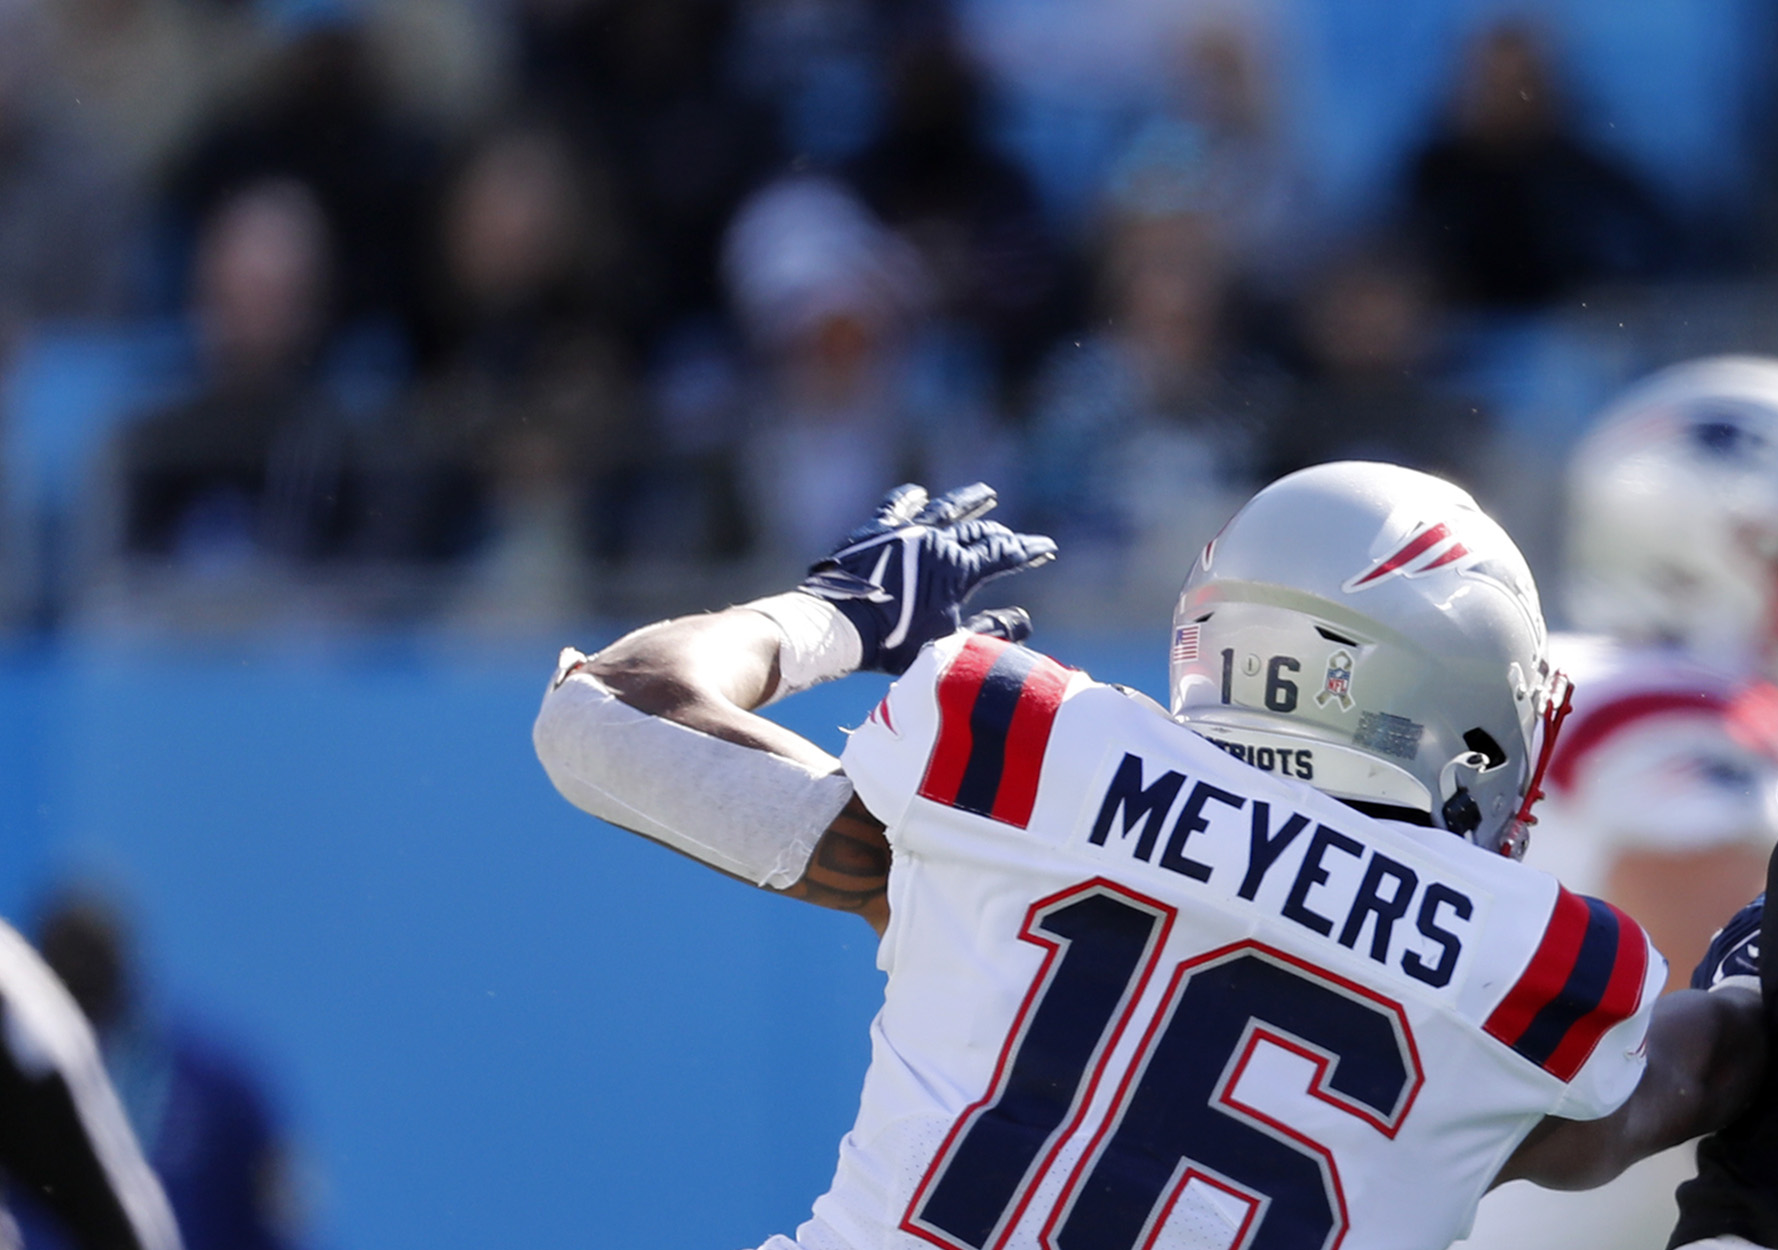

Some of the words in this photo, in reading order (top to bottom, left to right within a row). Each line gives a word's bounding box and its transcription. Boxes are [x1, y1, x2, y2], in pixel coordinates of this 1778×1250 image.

[1221, 648, 1301, 713] 16
[1200, 735, 1313, 780] RIOTS
[1088, 752, 1472, 989] MEYERS
